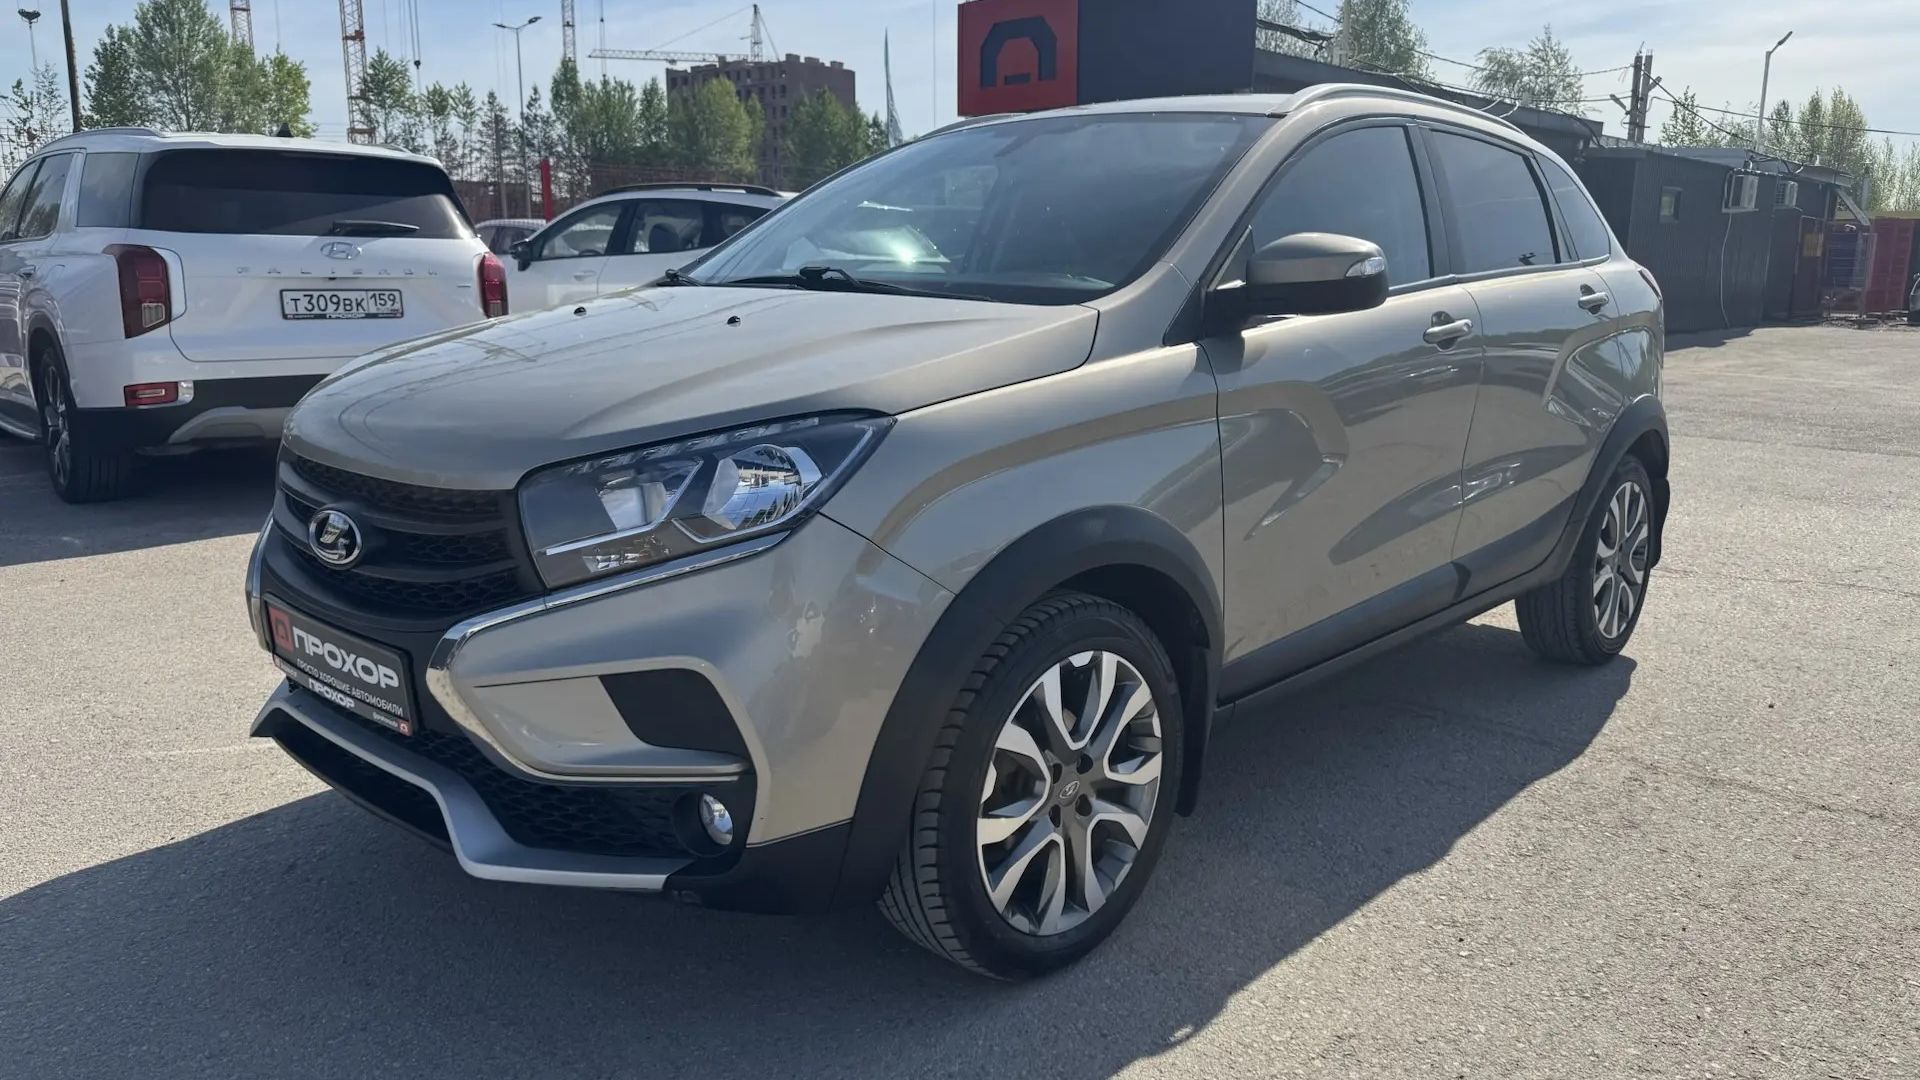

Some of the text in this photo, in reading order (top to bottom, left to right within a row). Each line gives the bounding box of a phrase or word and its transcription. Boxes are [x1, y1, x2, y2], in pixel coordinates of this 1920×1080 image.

[290, 293, 397, 312] Т309ВК 159
[292, 626, 399, 689] ПРОХОР
[297, 658, 319, 678] ПРОСТО
[351, 687, 404, 717] АВТОМОБИЛИ
[308, 678, 355, 709] ПРОХОР
